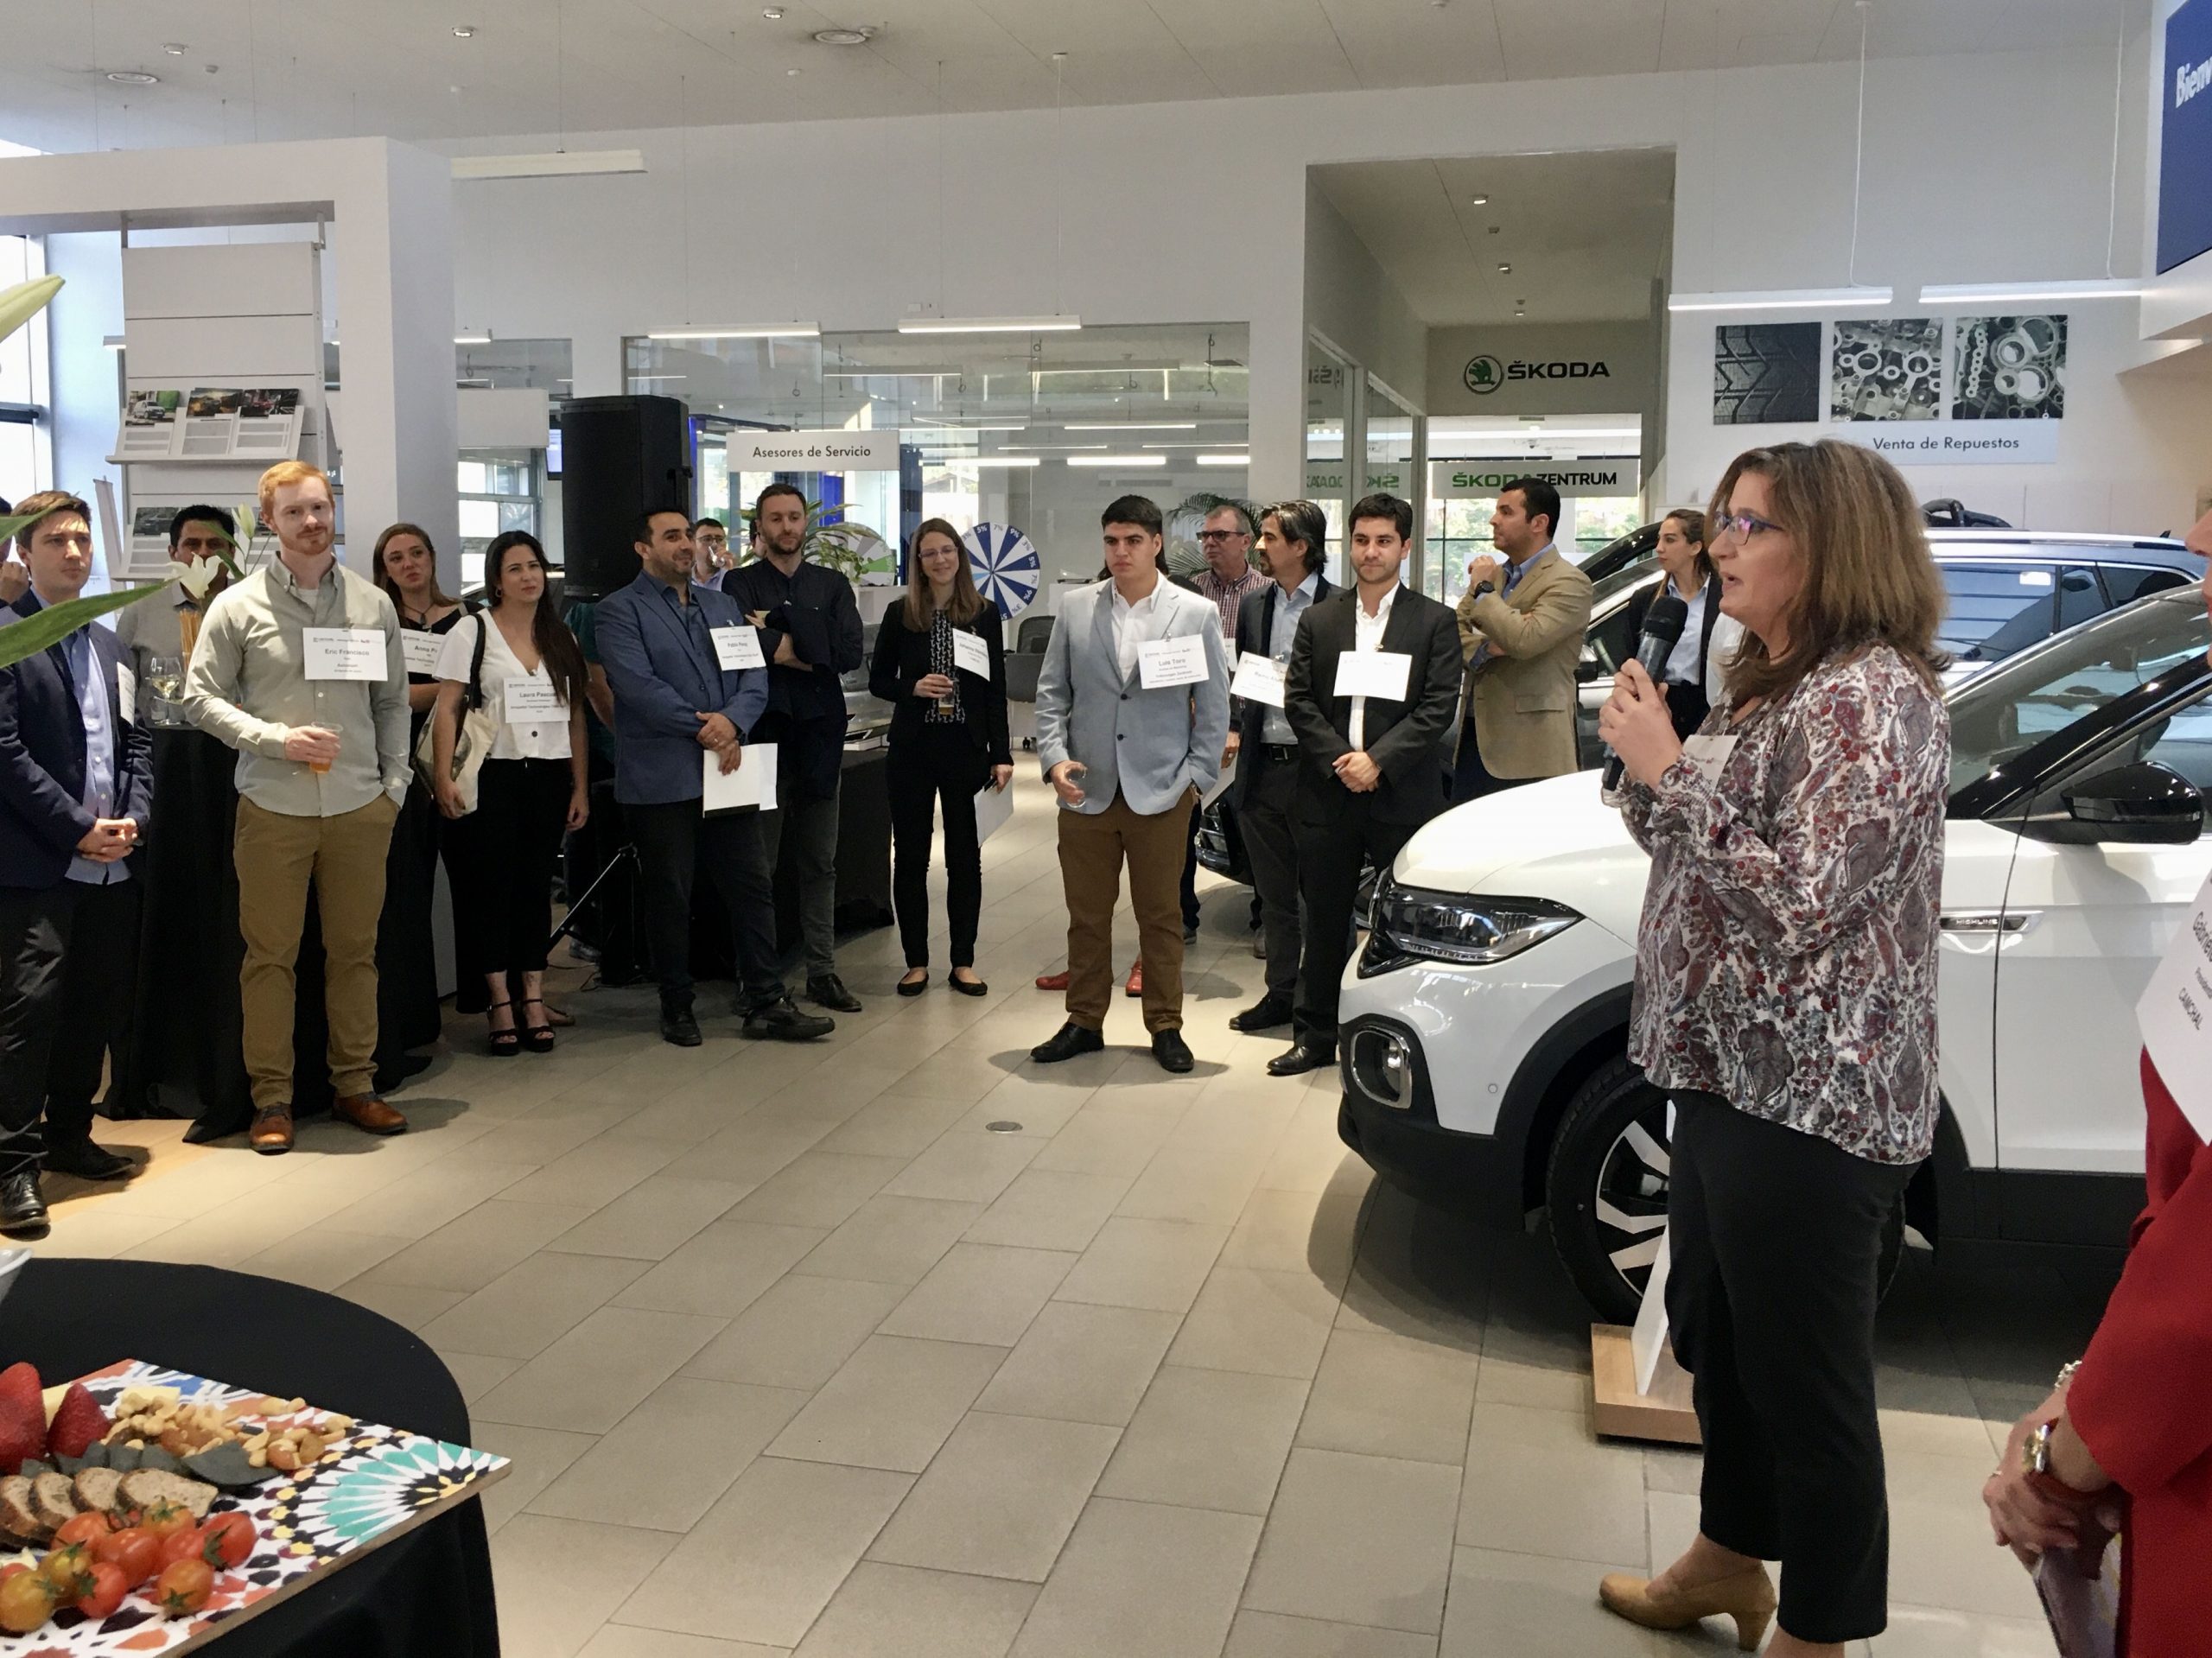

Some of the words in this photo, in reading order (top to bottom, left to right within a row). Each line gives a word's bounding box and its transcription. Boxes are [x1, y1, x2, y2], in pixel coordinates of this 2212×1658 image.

[1507, 360, 1611, 380] ŠKODA
[1872, 437, 1915, 450] Venta
[1920, 436, 1939, 449] de
[1943, 436, 2019, 452] Repuestos
[753, 446, 804, 458] Asesores
[807, 444, 822, 457] de
[825, 445, 871, 457] Servicio
[976, 524, 988, 533] 5%
[1010, 528, 1020, 538] 9%
[1028, 556, 1037, 569] 5%
